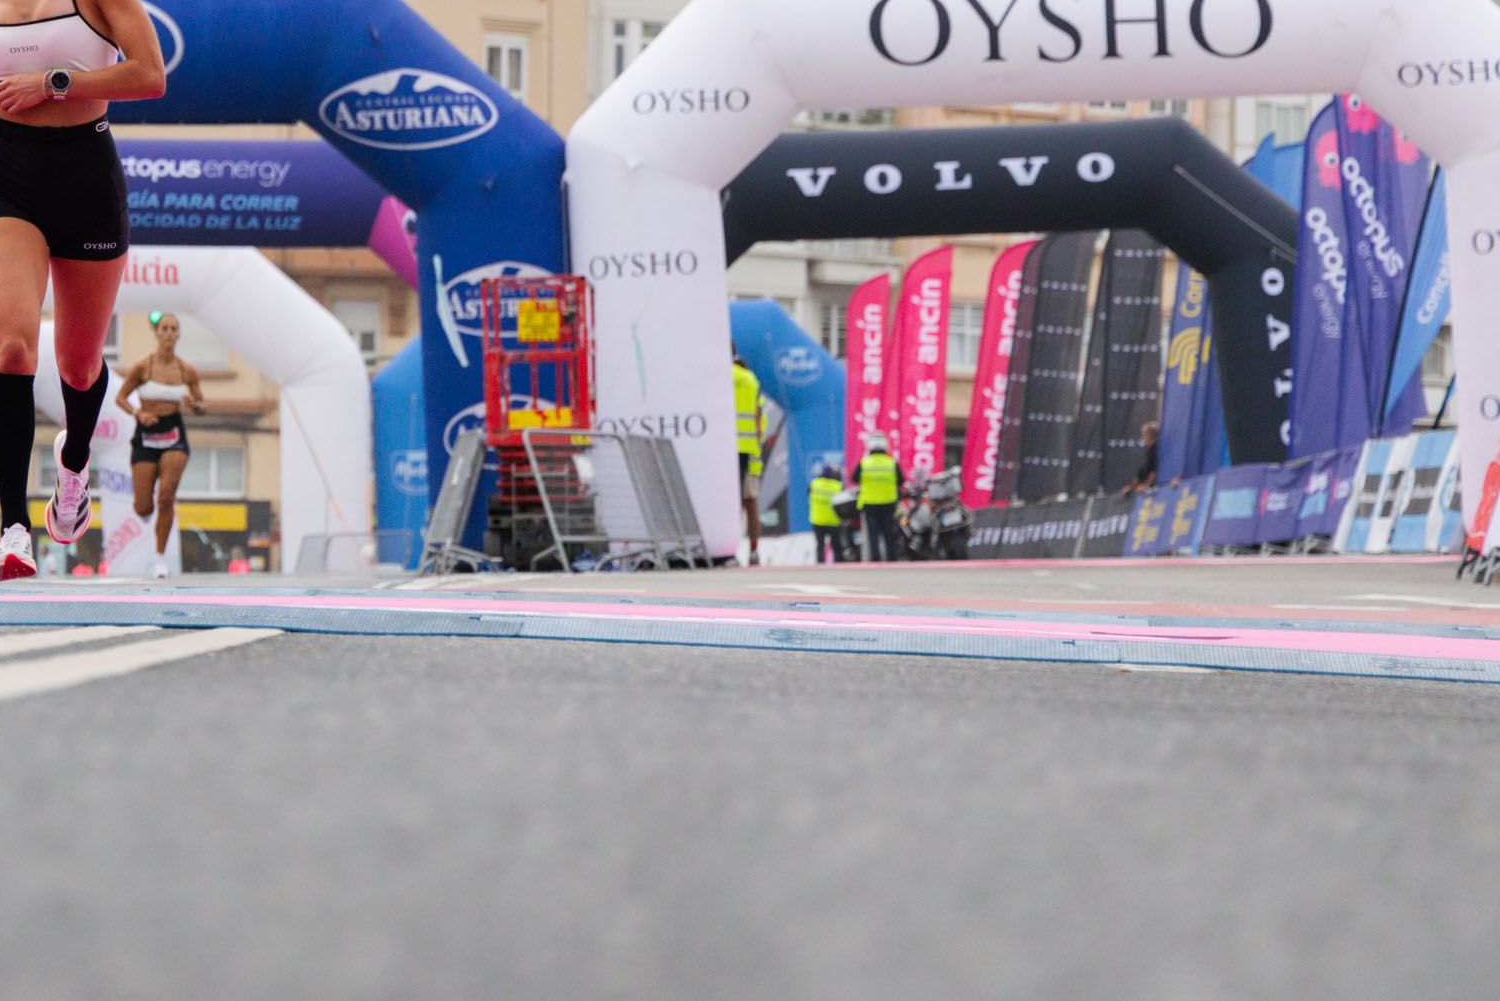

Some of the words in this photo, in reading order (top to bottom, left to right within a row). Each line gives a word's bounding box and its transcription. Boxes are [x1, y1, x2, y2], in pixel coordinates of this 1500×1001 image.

[9, 44, 40, 54] OYSHO
[1397, 58, 1500, 89] OYSH
[631, 86, 751, 115] OYSHO
[334, 100, 487, 132] ASTURIANA
[785, 152, 1116, 198] VOLVO
[163, 192, 216, 210] PARA
[219, 194, 300, 212] CORRER
[204, 215, 232, 229] DE
[235, 215, 258, 230] LA
[264, 216, 304, 231] LUZ
[83, 242, 117, 250] OYSHO
[588, 249, 699, 281] OYSHO
[906, 378, 937, 480] ordés
